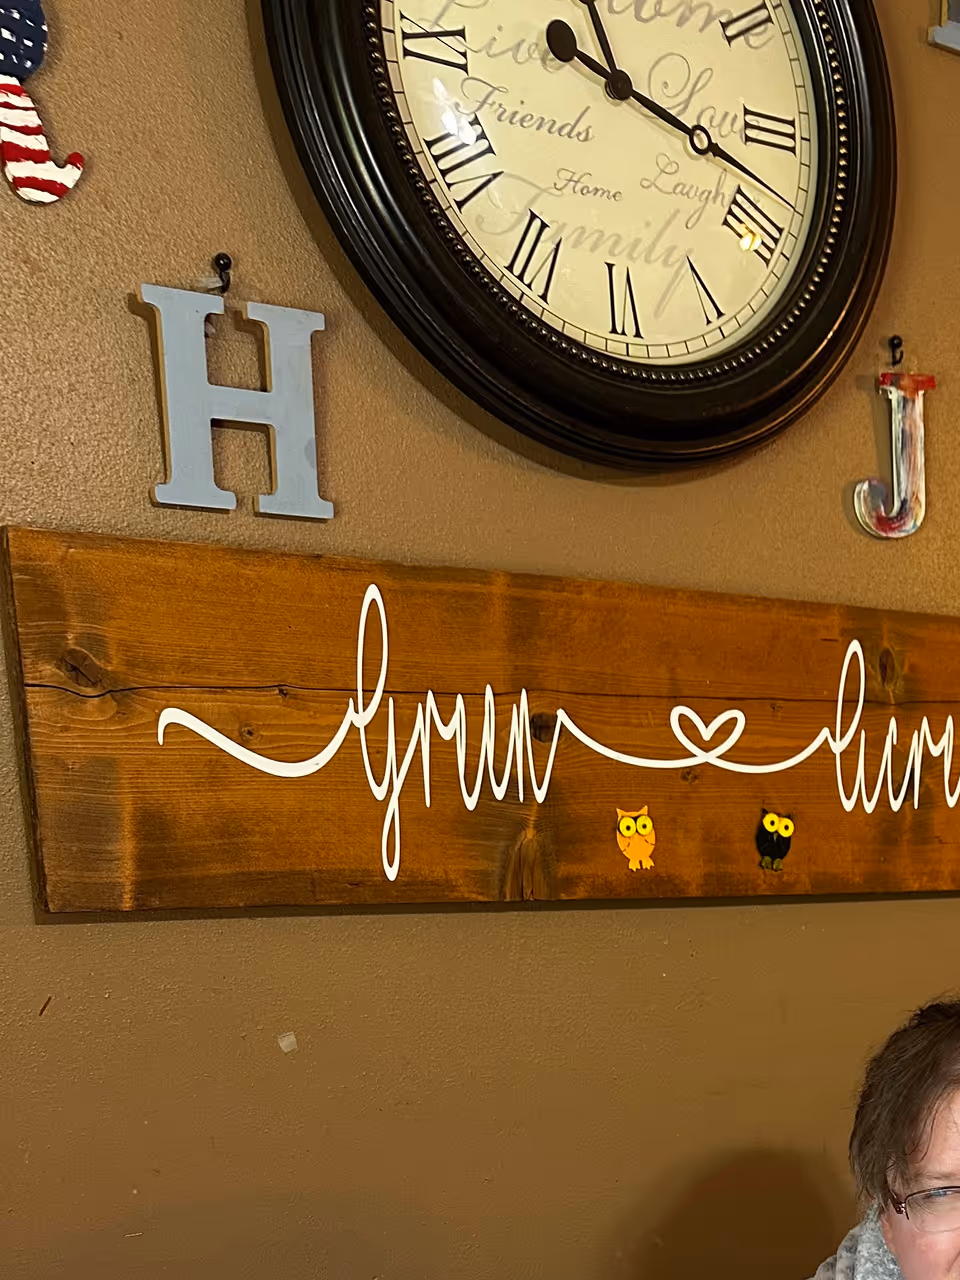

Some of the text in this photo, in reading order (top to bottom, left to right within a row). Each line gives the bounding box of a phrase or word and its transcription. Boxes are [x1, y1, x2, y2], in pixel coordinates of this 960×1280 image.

[453, 77, 596, 143] Friends
[475, 171, 696, 320] Family
[553, 167, 623, 203] Home
[140, 283, 335, 519] H
[854, 371, 936, 539] J
